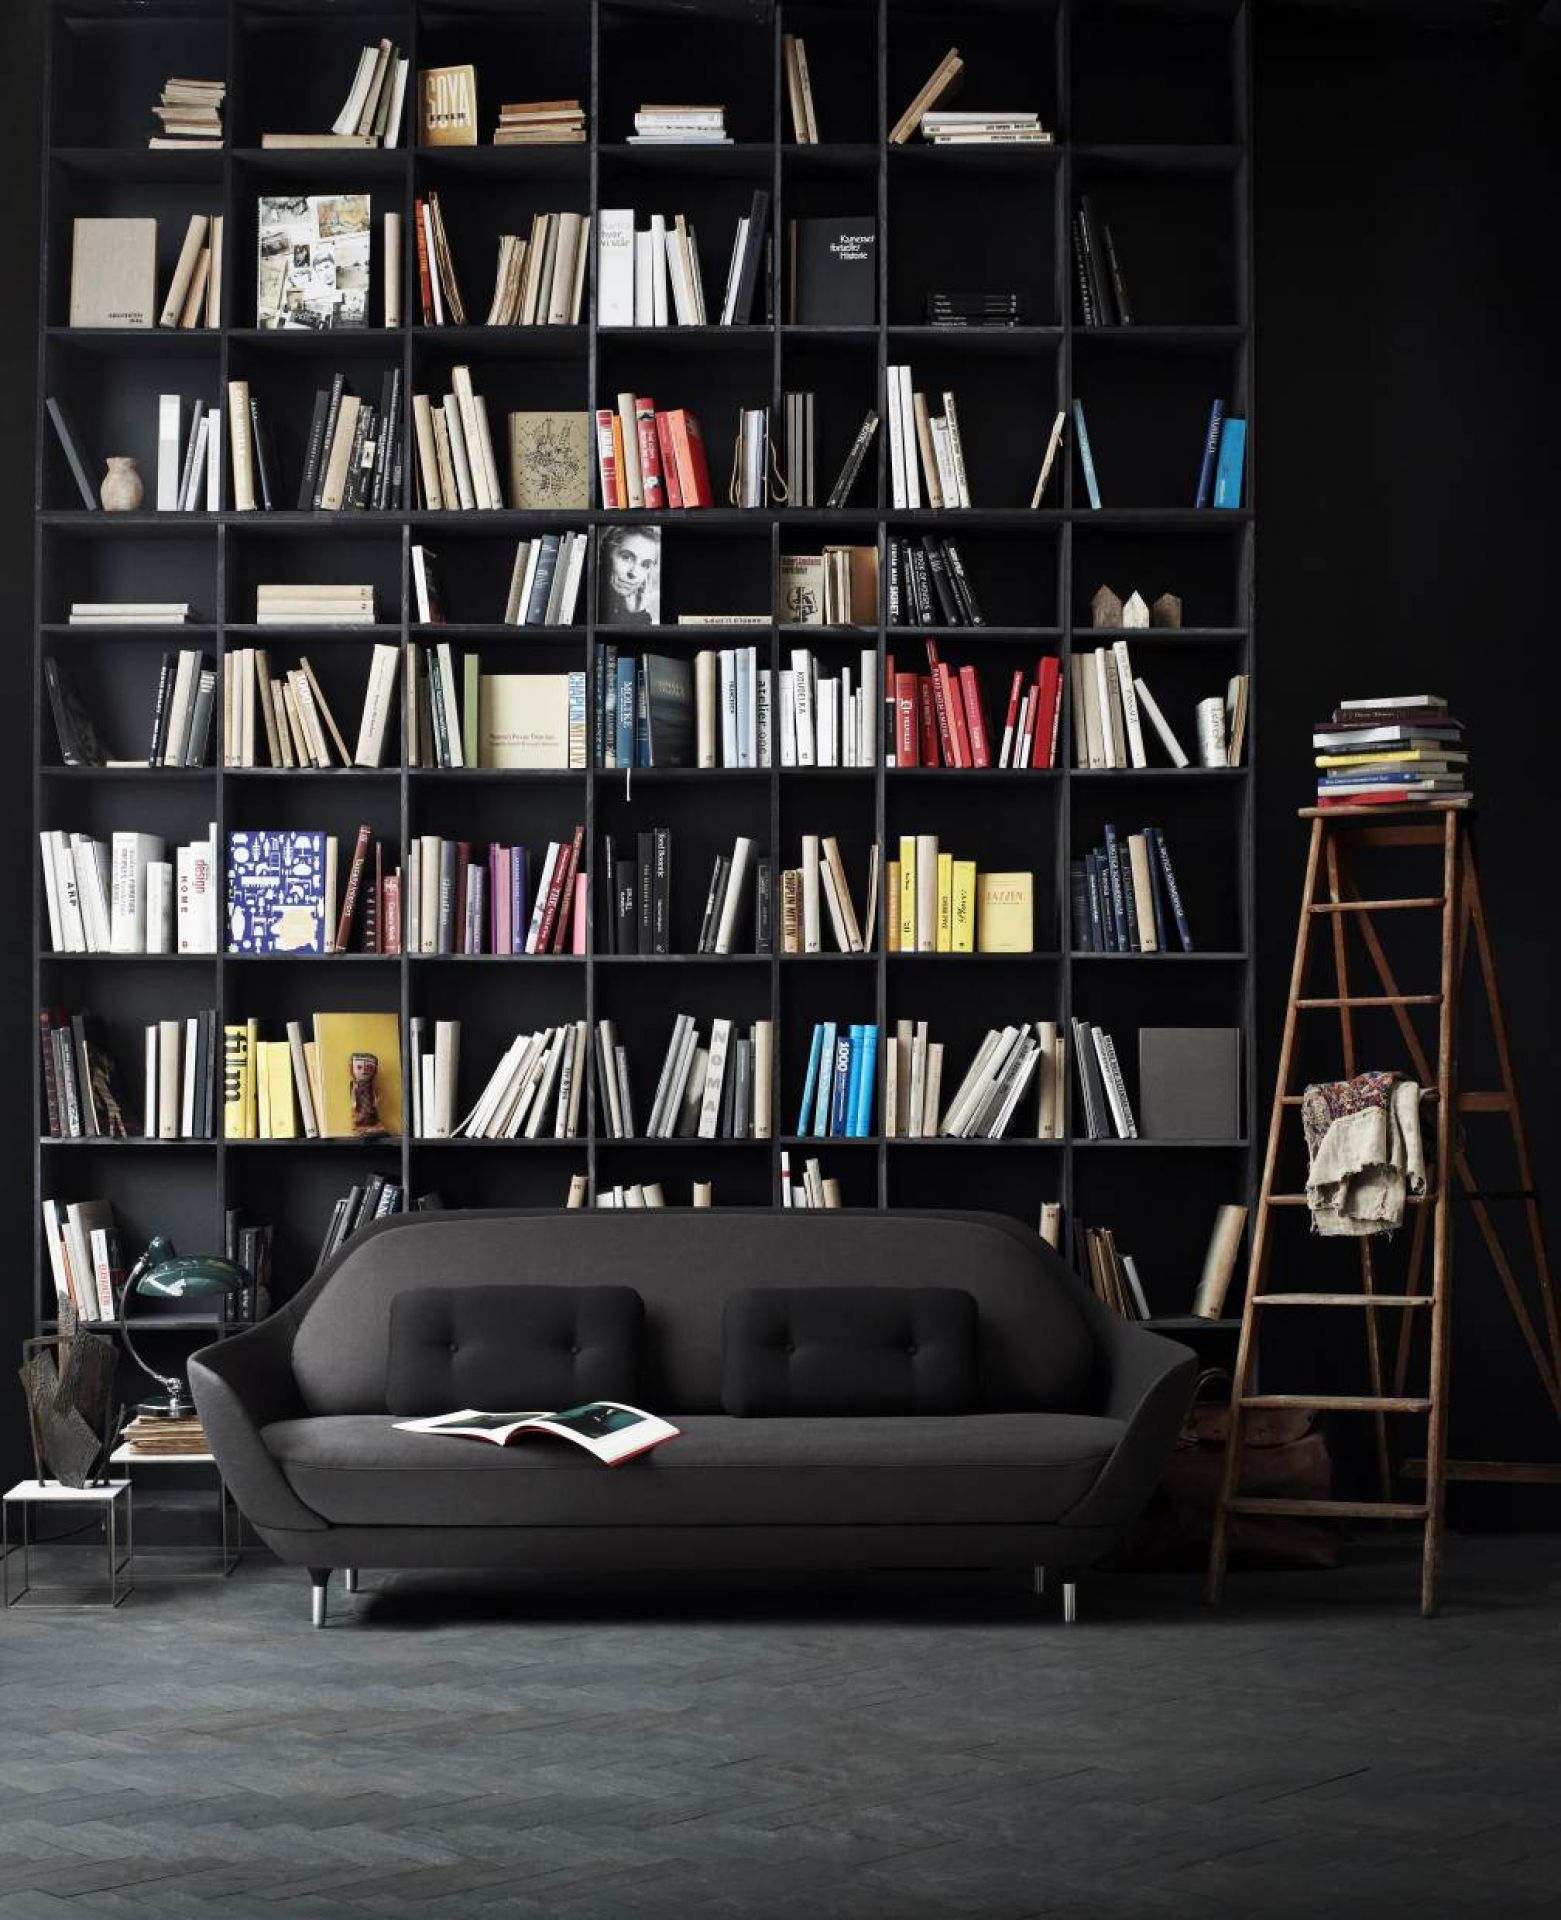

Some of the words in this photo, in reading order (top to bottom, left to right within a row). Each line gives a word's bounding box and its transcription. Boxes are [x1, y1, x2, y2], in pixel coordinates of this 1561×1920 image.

[623, 681, 634, 729] MOLTKE
[757, 681, 769, 727] atelier
[66, 882, 77, 907] ARP
[180, 876, 188, 913] HOME
[194, 859, 209, 895] design
[224, 1031, 247, 1102] film
[704, 1031, 727, 1112] NOMA
[837, 1040, 851, 1073] 1000
